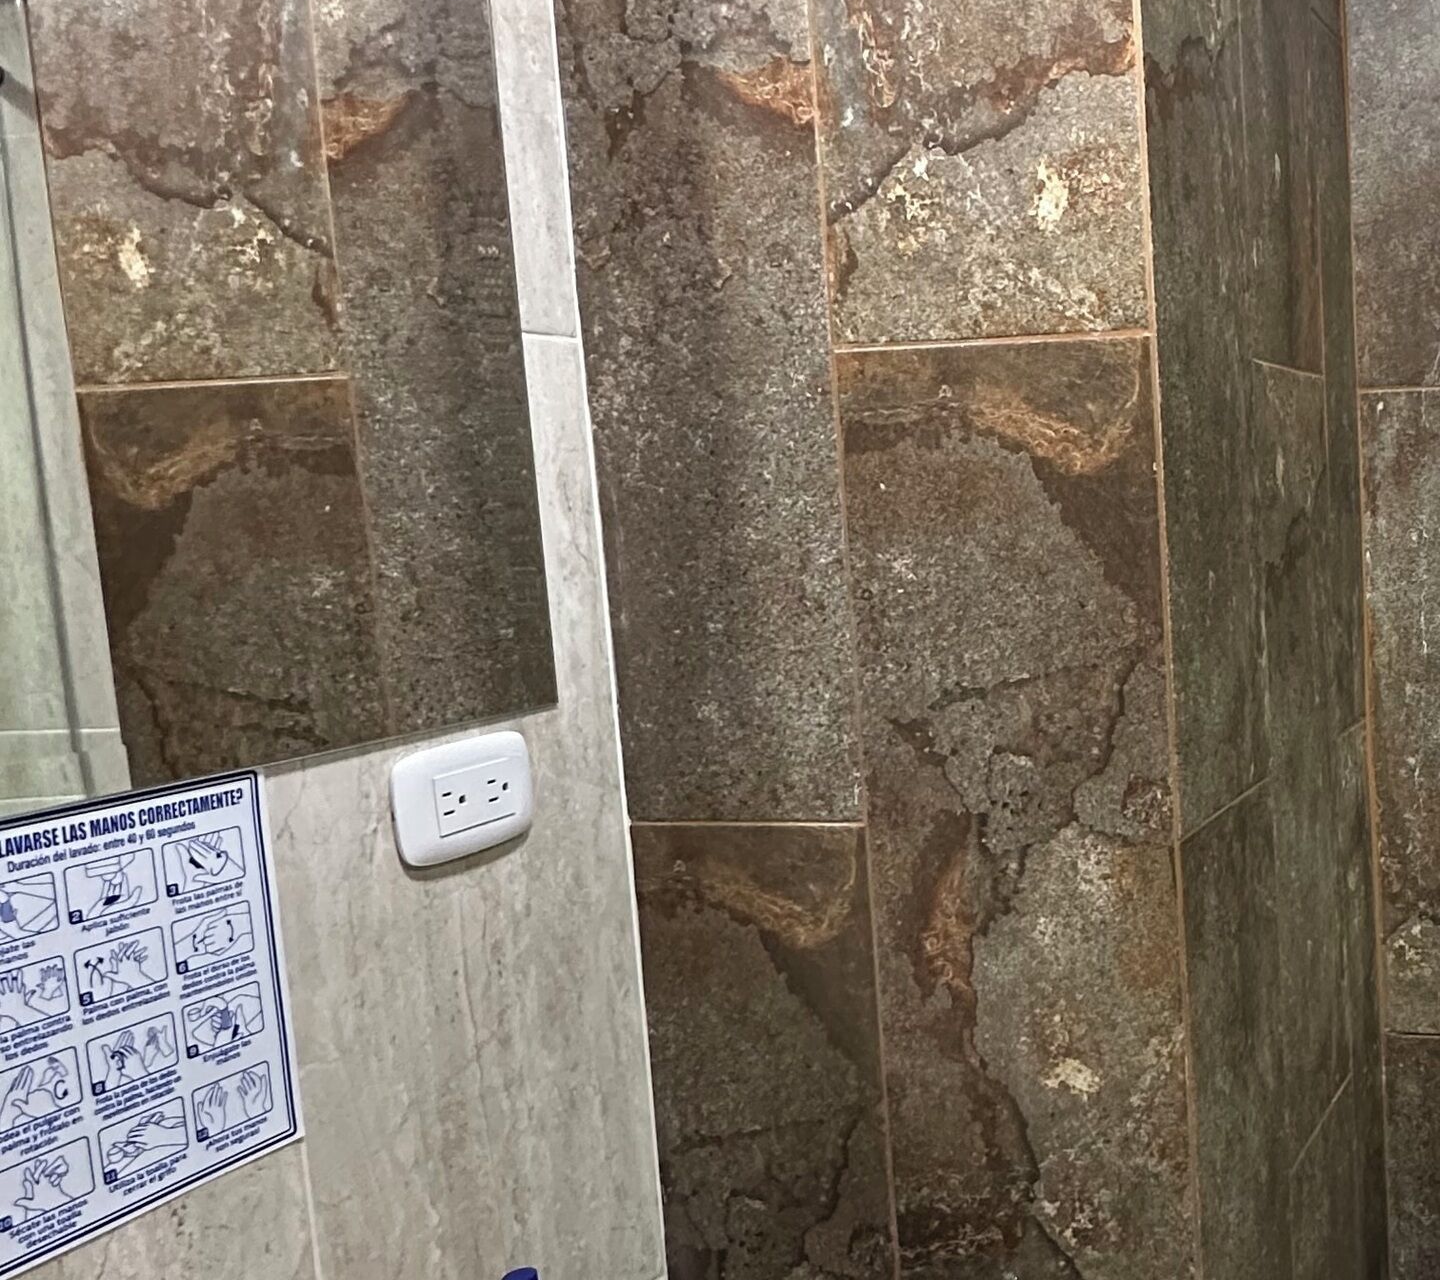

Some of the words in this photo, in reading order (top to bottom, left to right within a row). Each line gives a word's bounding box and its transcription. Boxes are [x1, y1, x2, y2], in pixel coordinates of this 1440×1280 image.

[61, 822, 87, 844] LAS
[89, 811, 136, 837] MANOS
[138, 788, 243, 826] CORRECTAMENTE?
[7, 854, 51, 873] Duración
[53, 849, 66, 862] del
[68, 843, 101, 858] lavado:
[103, 838, 125, 851] entre
[127, 833, 137, 844] 40
[139, 834, 143, 845] y
[157, 821, 195, 838] segundos
[171, 896, 192, 906] Frota
[193, 892, 204, 900] las
[205, 884, 233, 898] palmas
[234, 881, 243, 889] de
[175, 906, 186, 914] las
[188, 899, 214, 911] manos
[214, 893, 234, 903] entre
[71, 911, 80, 922] 2
[81, 920, 107, 932] Aplica
[109, 908, 150, 924] suficiente
[105, 923, 130, 937] jabón
[22, 940, 36, 949] las
[182, 980, 202, 991] dedos
[204, 971, 226, 983] contra
[235, 961, 255, 973] palma
[183, 971, 202, 981] Frota
[210, 962, 230, 973] dorso
[82, 992, 91, 1004] 5
[82, 1003, 109, 1016] Palma
[110, 997, 125, 1007] con
[126, 989, 153, 1002] palma,
[153, 983, 168, 992] con
[82, 1017, 94, 1025] los
[95, 1008, 120, 1021] dedos
[121, 990, 170, 1012] entrelazados
[10, 1026, 39, 1042] palma
[41, 1015, 71, 1030] contra
[13, 1024, 73, 1049] entrelazando
[5, 1052, 19, 1061] los
[20, 1042, 49, 1056] dedos
[202, 1044, 240, 1063] Enjuágate
[240, 1039, 252, 1048] las
[216, 1052, 241, 1066] manos
[94, 1103, 116, 1116] contra
[145, 1079, 173, 1094] haciendo
[95, 1095, 113, 1106] Frota
[120, 1084, 140, 1097] punta
[140, 1080, 148, 1088] de
[158, 1069, 177, 1080] dedos
[149, 1087, 175, 1101] rotación
[22, 1125, 31, 1134] el
[33, 1113, 61, 1131] pulgar
[63, 1107, 80, 1118] con
[231, 1128, 243, 1137] tus
[244, 1116, 267, 1131] manos
[1, 1137, 31, 1155] palma
[39, 1121, 71, 1138] frótalo
[71, 1116, 83, 1125] en
[20, 1136, 58, 1156] rotación
[215, 1142, 229, 1152] son
[108, 1177, 136, 1193] Utiliza
[145, 1162, 169, 1176] toalla
[169, 1153, 187, 1166] para
[123, 1180, 147, 1196] cerrar
[149, 1175, 156, 1184] el
[157, 1167, 176, 1182] grifo
[9, 1216, 41, 1239] Sécate
[42, 1213, 56, 1224] las
[58, 1199, 88, 1216] manos
[18, 1232, 36, 1244] con
[37, 1223, 55, 1235] una
[56, 1210, 82, 1226] toalla
[26, 1221, 77, 1249] desechable
